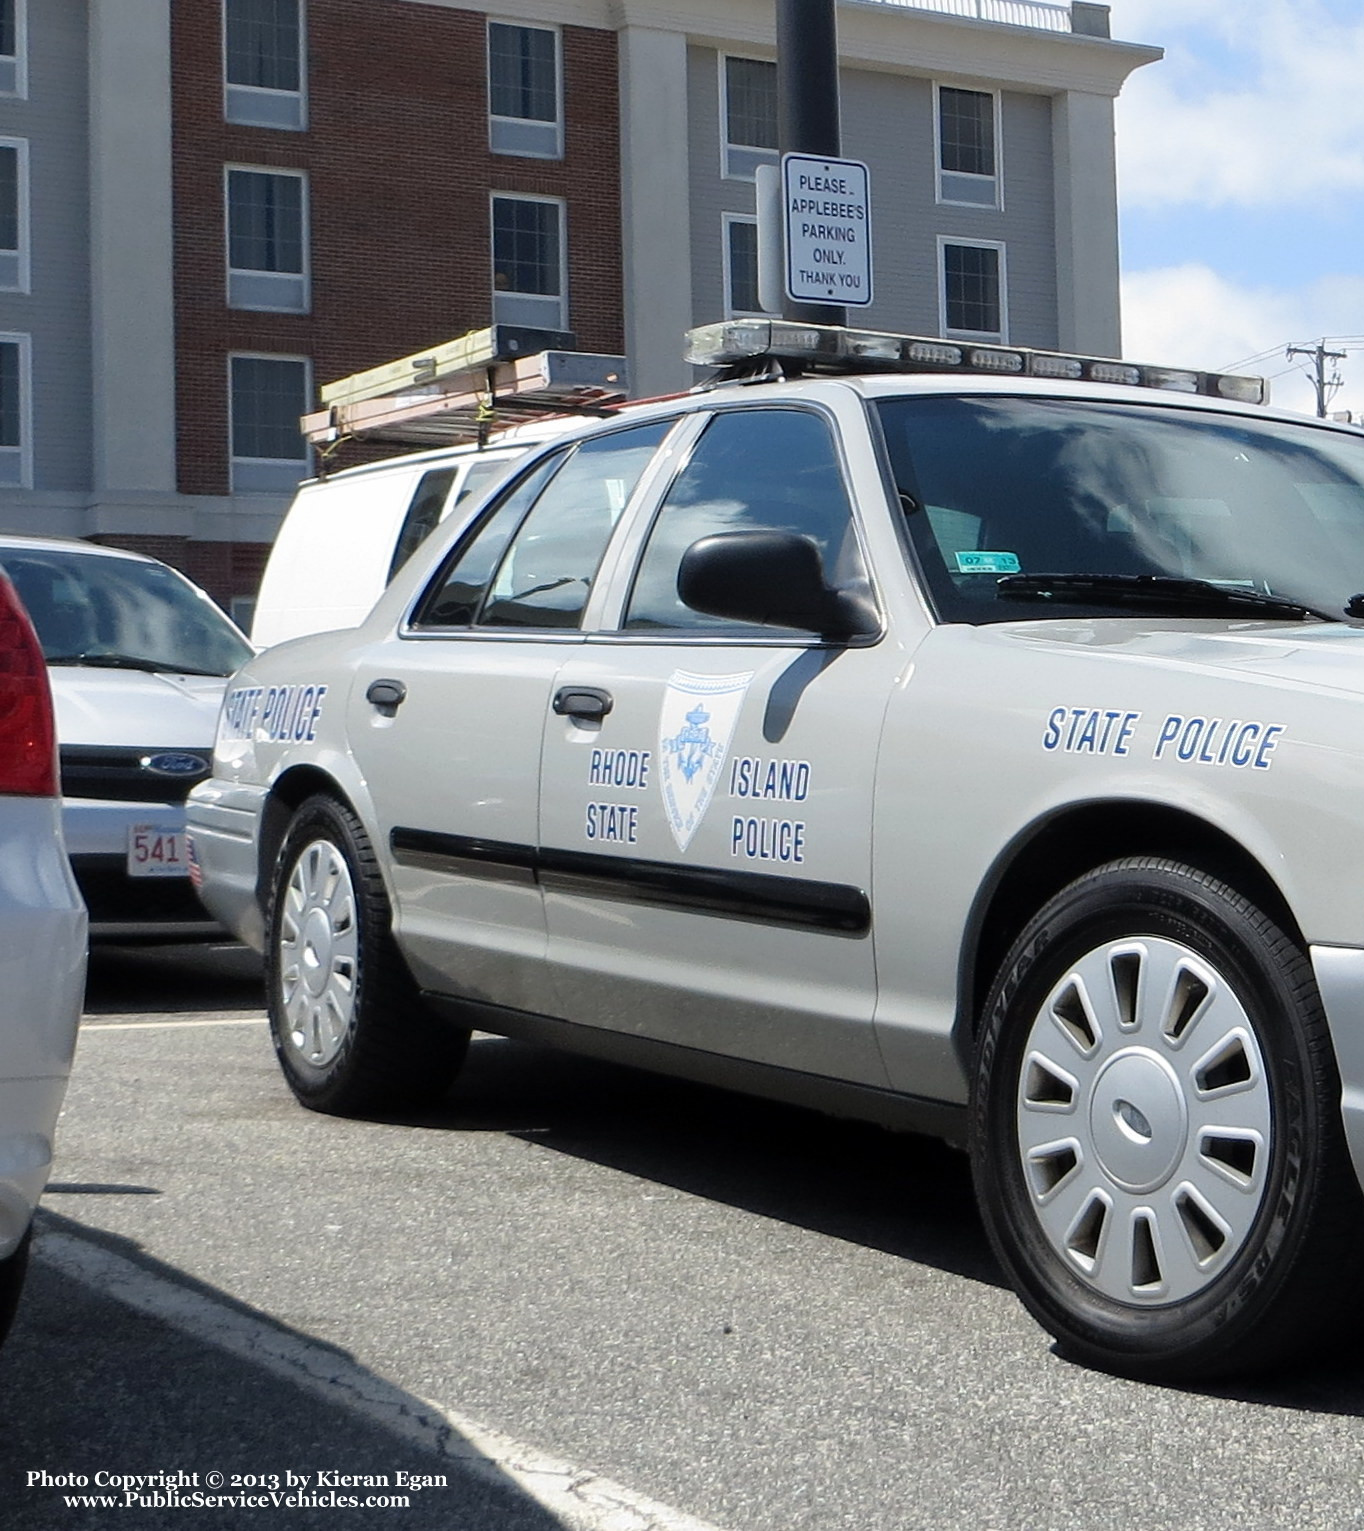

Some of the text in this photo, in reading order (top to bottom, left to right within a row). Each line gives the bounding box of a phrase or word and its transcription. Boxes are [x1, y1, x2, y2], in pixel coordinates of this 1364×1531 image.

[791, 198, 864, 220] APPLEBEE'S
[802, 223, 856, 243] PARKING
[813, 248, 846, 265] ONLY.
[799, 270, 861, 289] THANK YOU
[260, 684, 328, 744] POLICE
[1042, 705, 1288, 771] STATE POLICE
[161, 756, 194, 770] Ford
[590, 748, 650, 788] RHODE
[730, 757, 811, 802] ISLAND
[585, 802, 638, 844] STATE
[731, 815, 804, 864] POLICE
[134, 835, 180, 863] 541
